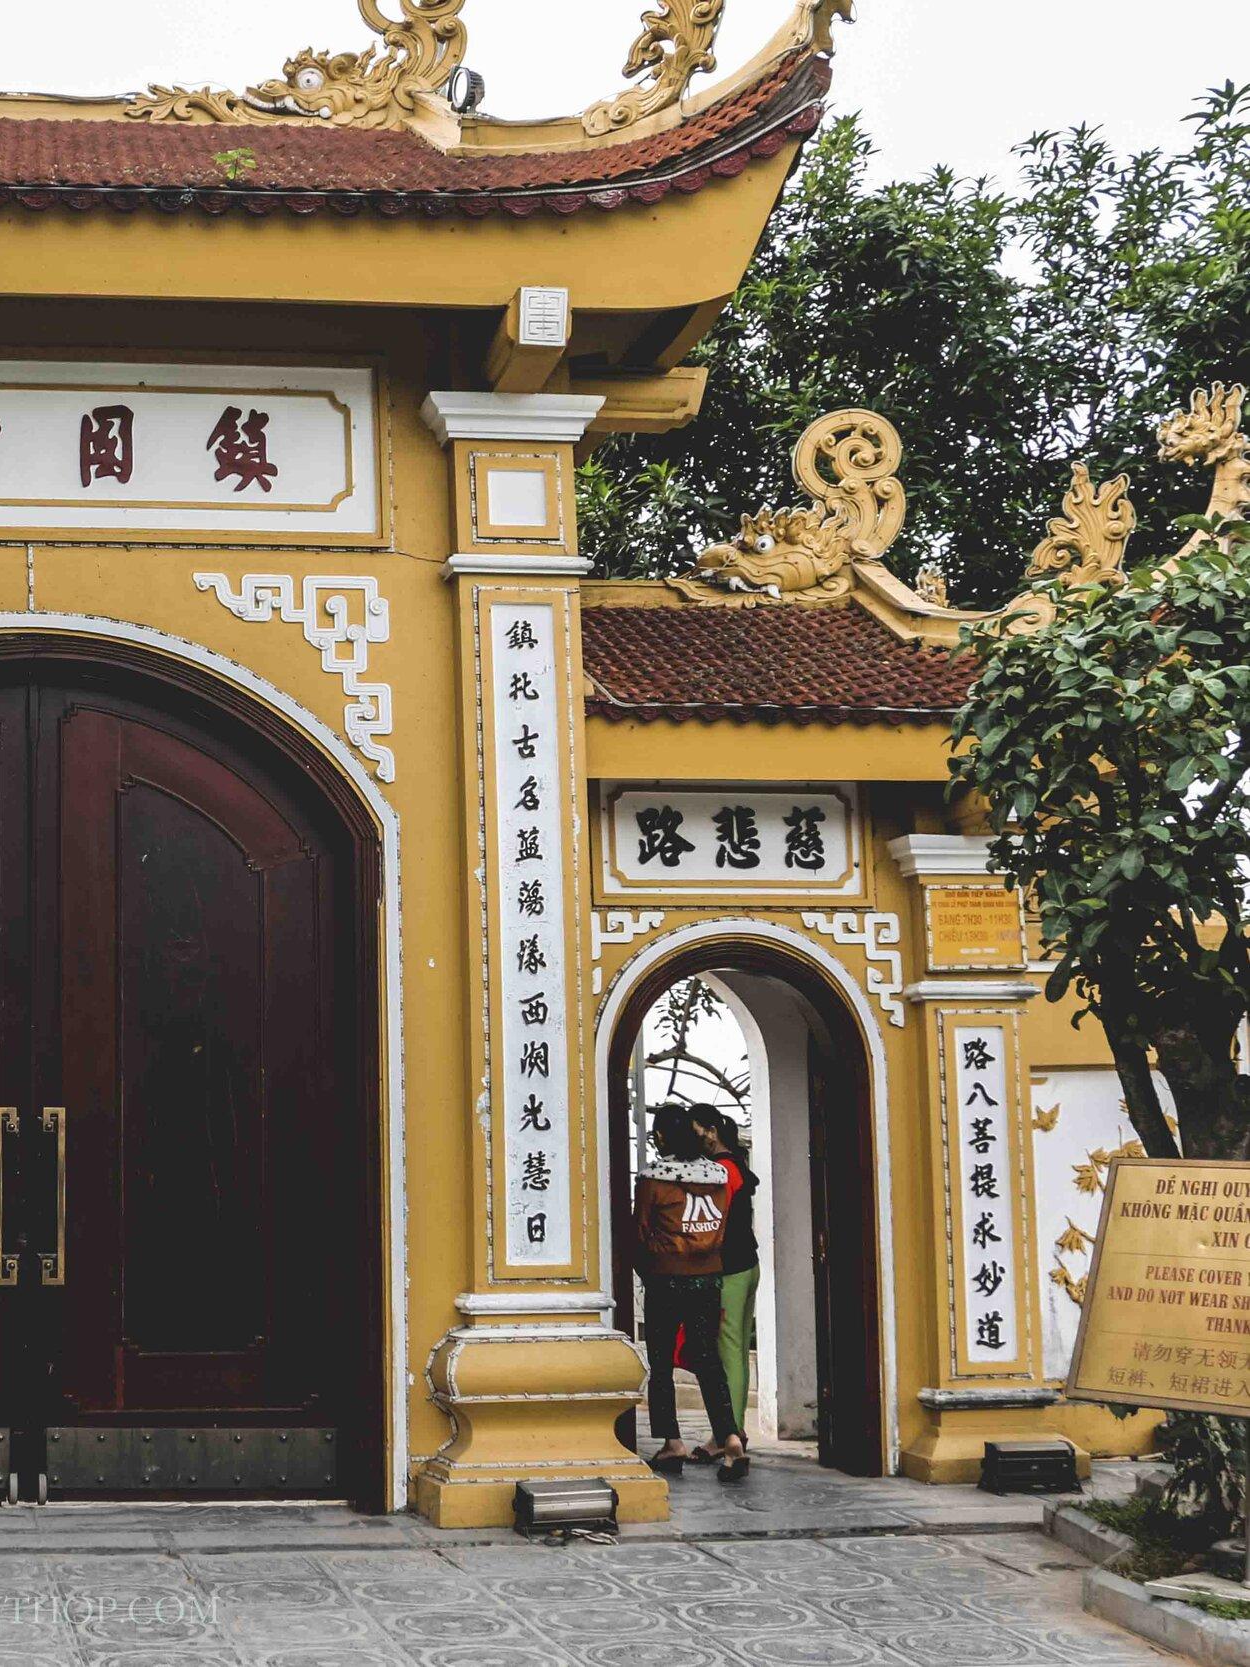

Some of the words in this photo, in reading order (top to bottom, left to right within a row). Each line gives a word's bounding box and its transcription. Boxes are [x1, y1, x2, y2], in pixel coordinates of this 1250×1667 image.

[1120, 1200, 1171, 1220] KHÔNG
[1211, 1231, 1240, 1249] XIN
[1145, 1265, 1195, 1283] PLEASE
[1199, 1269, 1243, 1287] COVER
[1107, 1286, 1133, 1301] AND
[1137, 1287, 1155, 1302] DO
[1159, 1289, 1186, 1305] NOT
[1189, 1291, 1228, 1308] WEAR
